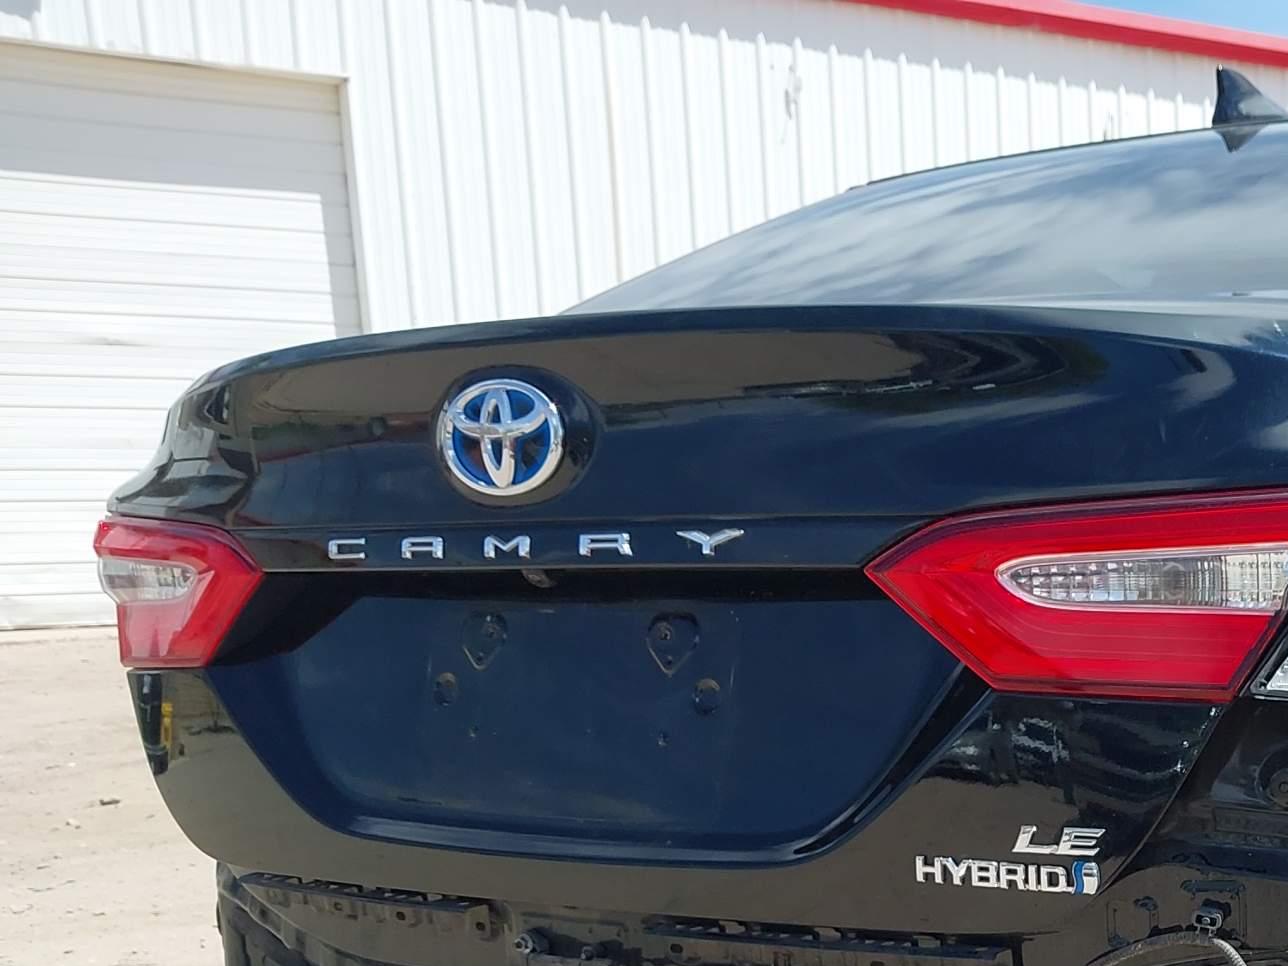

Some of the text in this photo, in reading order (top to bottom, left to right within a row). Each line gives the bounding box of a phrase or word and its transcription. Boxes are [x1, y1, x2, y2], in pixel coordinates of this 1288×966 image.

[328, 528, 745, 561] CAMRY
[1011, 824, 1107, 857] LE
[915, 855, 1073, 894] HYBRID
